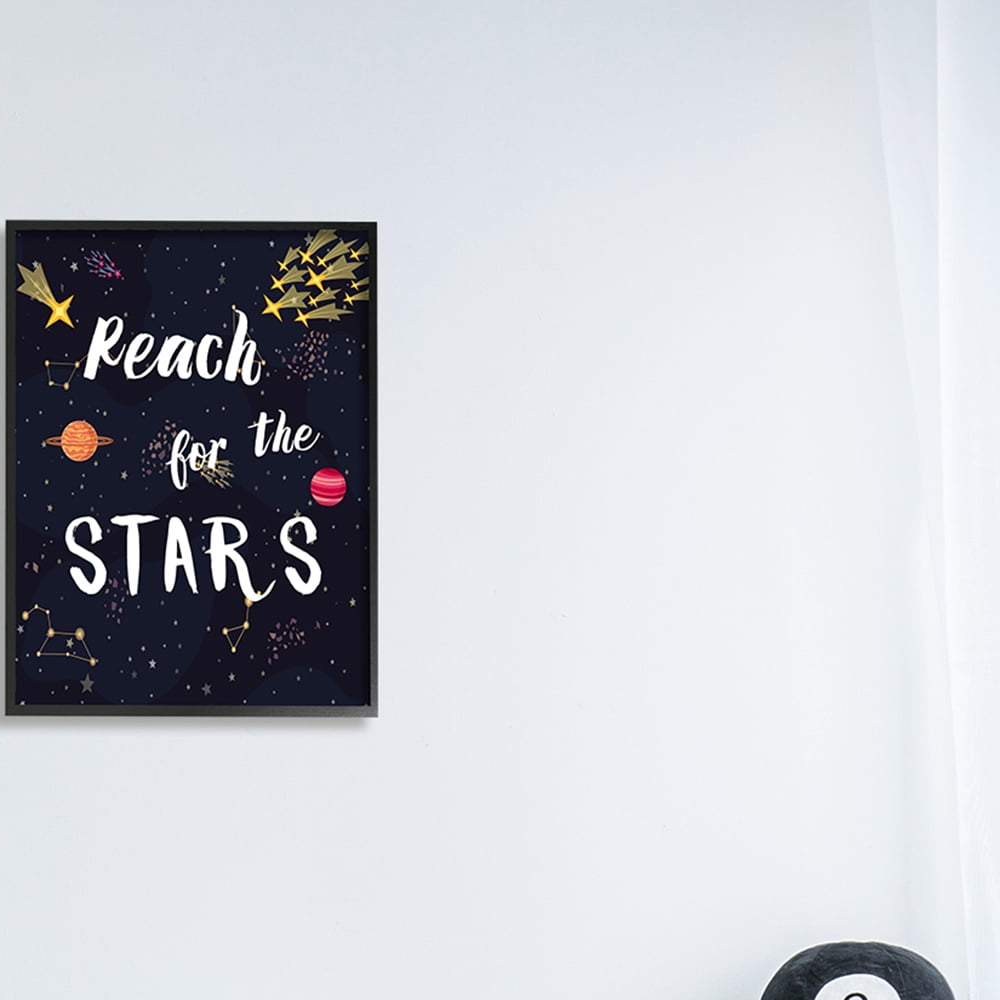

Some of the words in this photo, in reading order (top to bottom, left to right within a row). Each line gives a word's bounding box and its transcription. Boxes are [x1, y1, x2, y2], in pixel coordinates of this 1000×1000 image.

[83, 309, 262, 386] Reach
[167, 429, 227, 490] for
[247, 409, 320, 458] the
[64, 514, 323, 602] STARS
